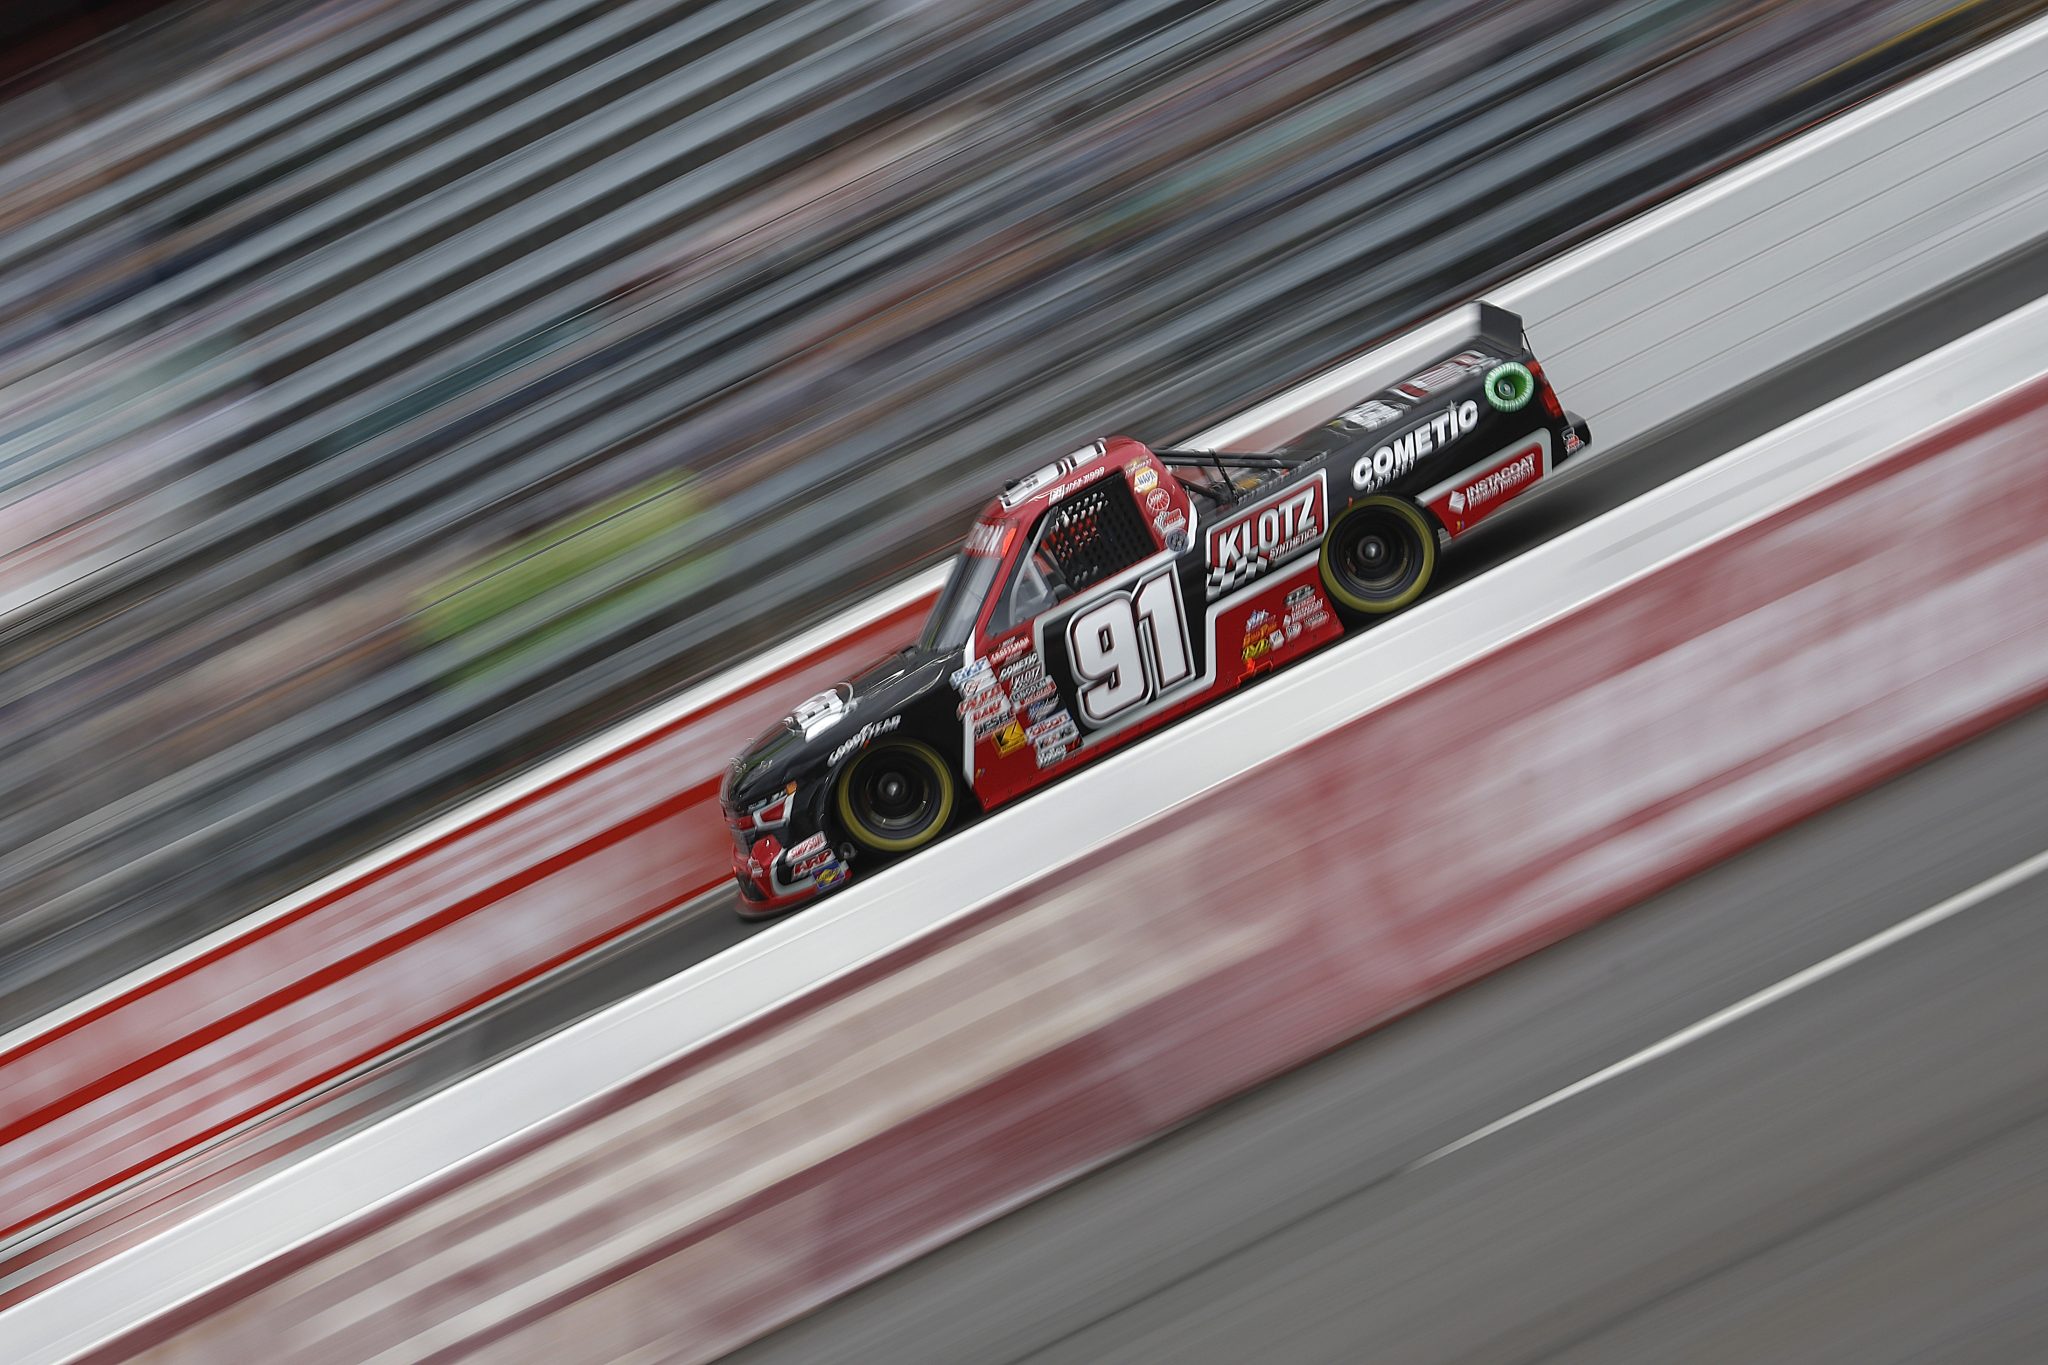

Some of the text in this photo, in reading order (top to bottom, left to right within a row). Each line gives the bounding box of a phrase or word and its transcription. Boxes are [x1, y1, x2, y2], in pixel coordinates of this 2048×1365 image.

[1352, 400, 1479, 491] COMETIC
[1137, 470, 1156, 486] NAPA
[1466, 453, 1535, 500] INSTACOAT
[1219, 487, 1315, 568] KLOTZ
[1269, 526, 1318, 560] SYNTHETICS
[1065, 561, 1196, 729] 91
[999, 653, 1038, 680] COMETIC
[1013, 666, 1041, 689] KLOTZ
[827, 714, 902, 768] GOODYEAR
[790, 833, 825, 859] SIMPSON
